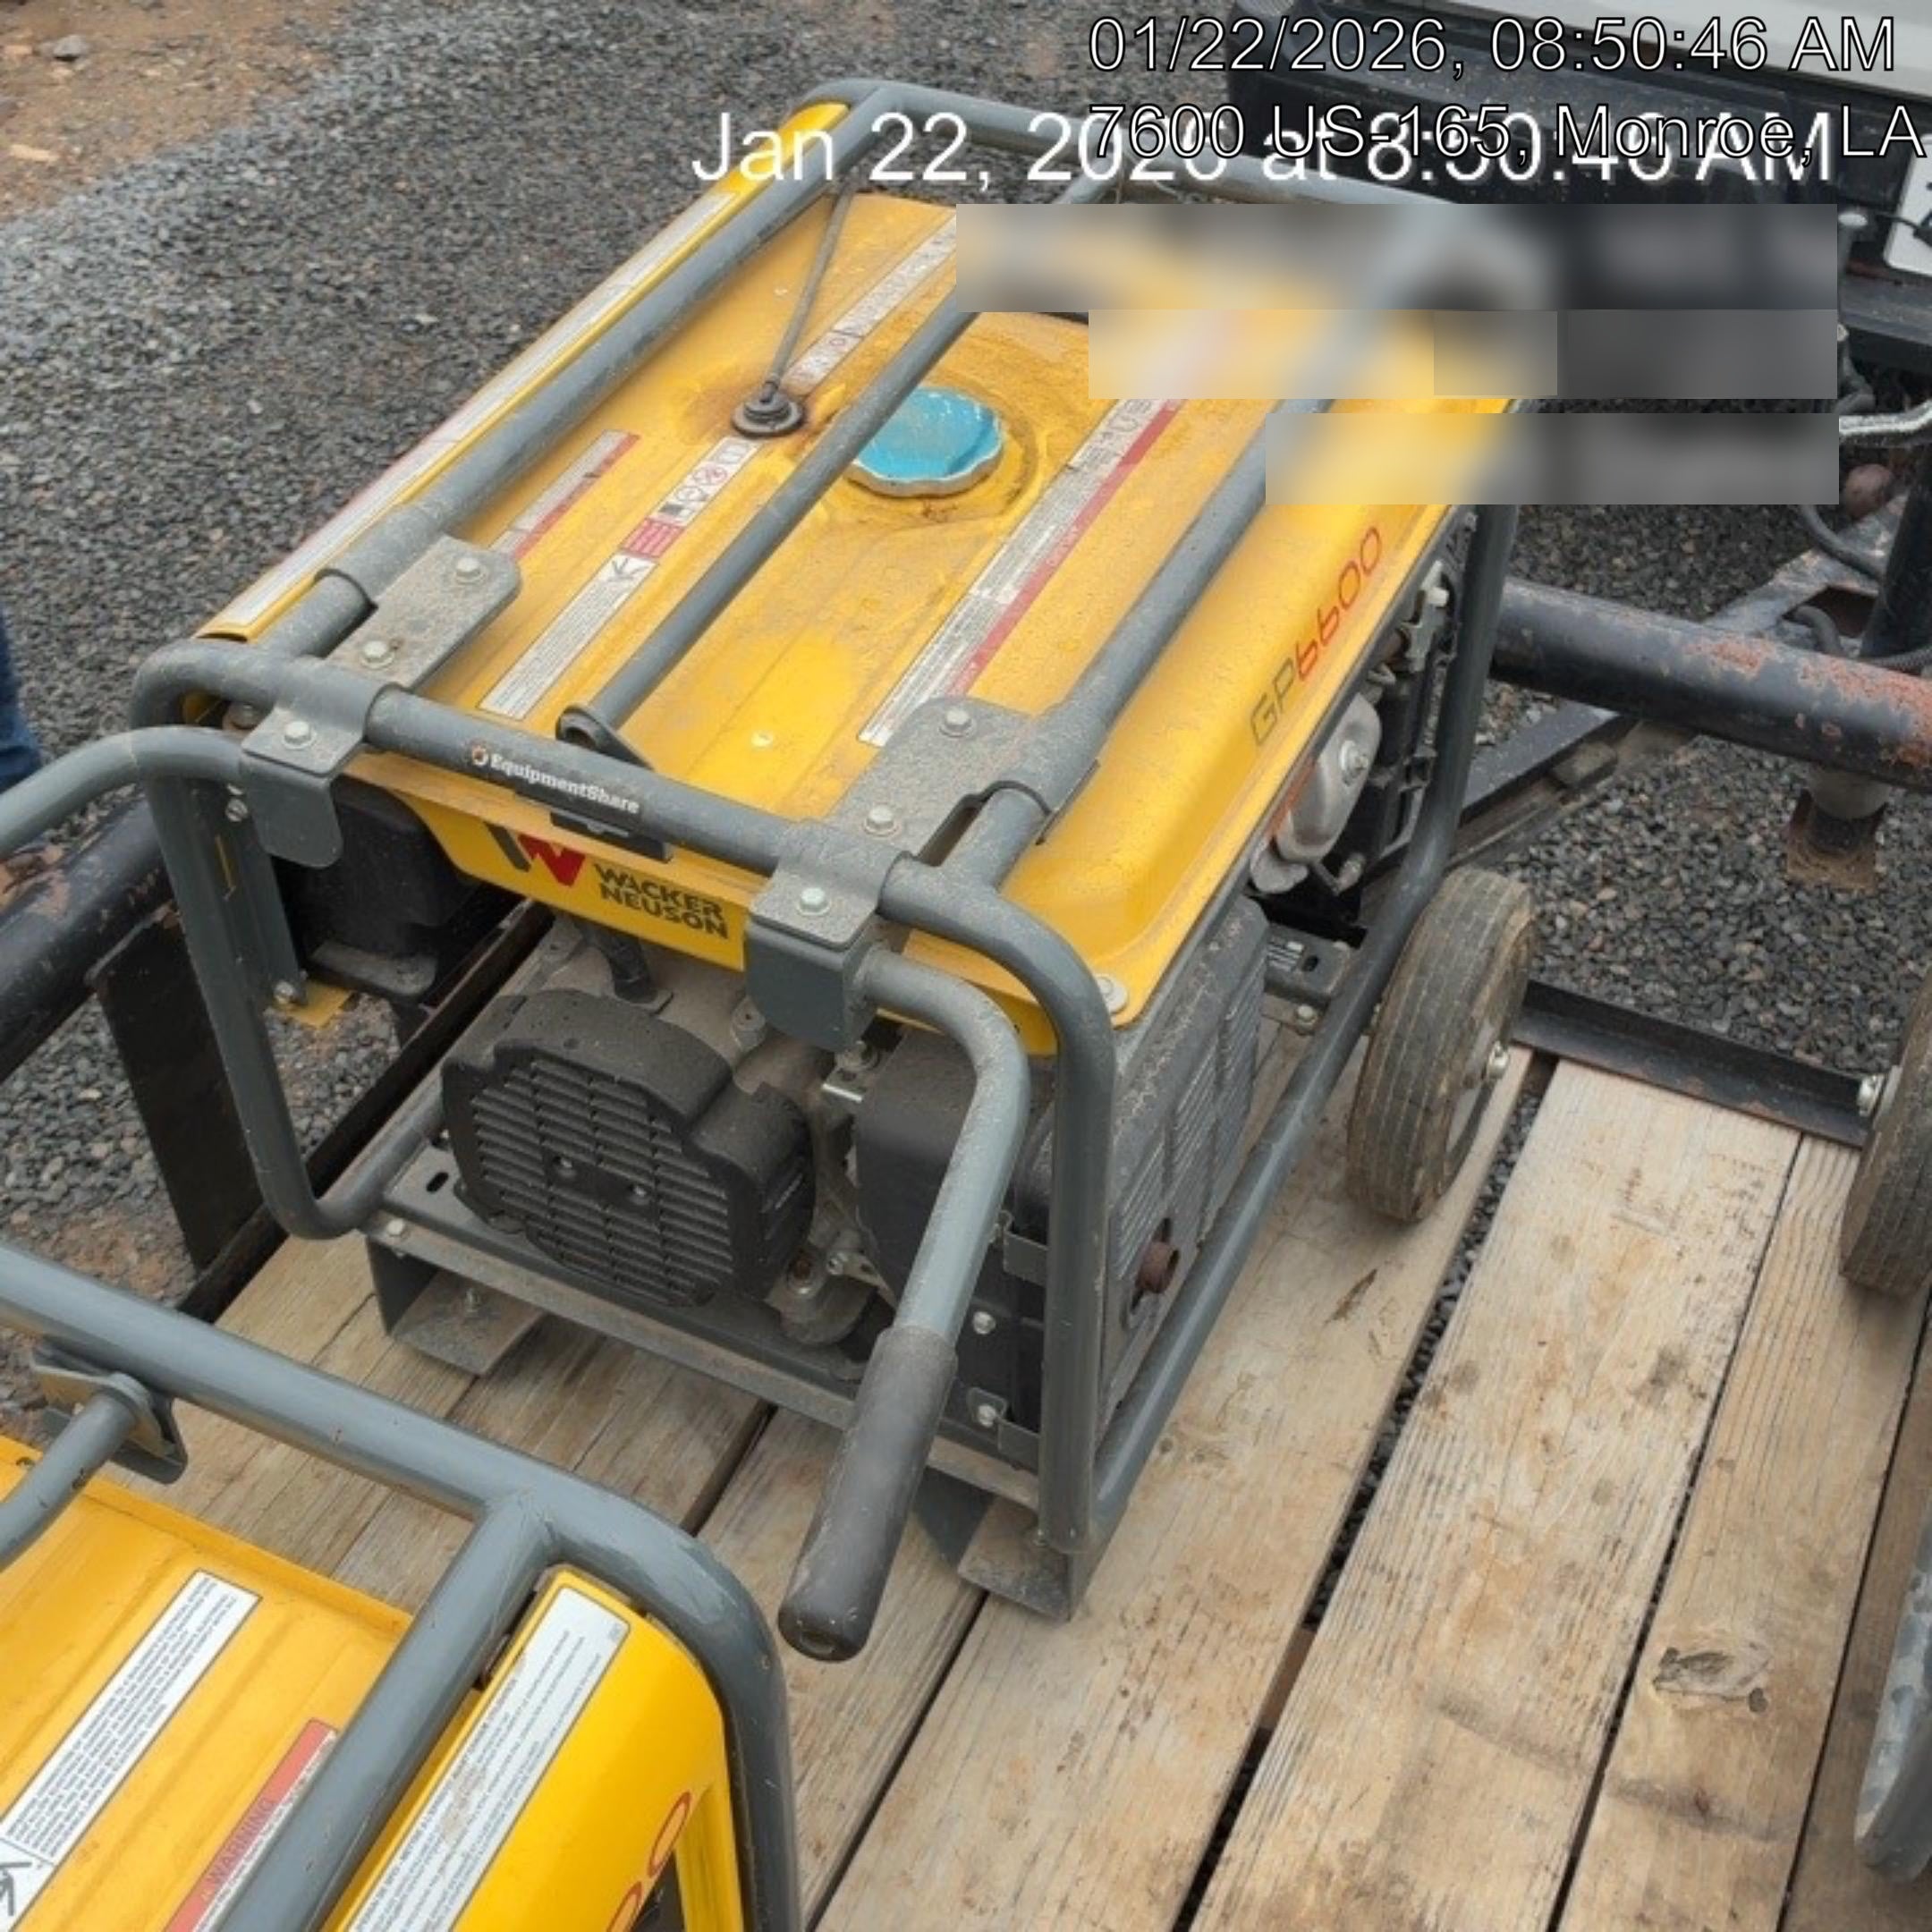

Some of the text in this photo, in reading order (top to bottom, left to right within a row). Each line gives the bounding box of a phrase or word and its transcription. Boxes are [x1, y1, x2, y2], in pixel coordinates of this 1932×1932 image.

[1250, 525, 1382, 747] GP6600
[489, 752, 640, 815] EquipmentShare
[593, 862, 724, 919] WACKER
[598, 882, 729, 940] NEUSON
